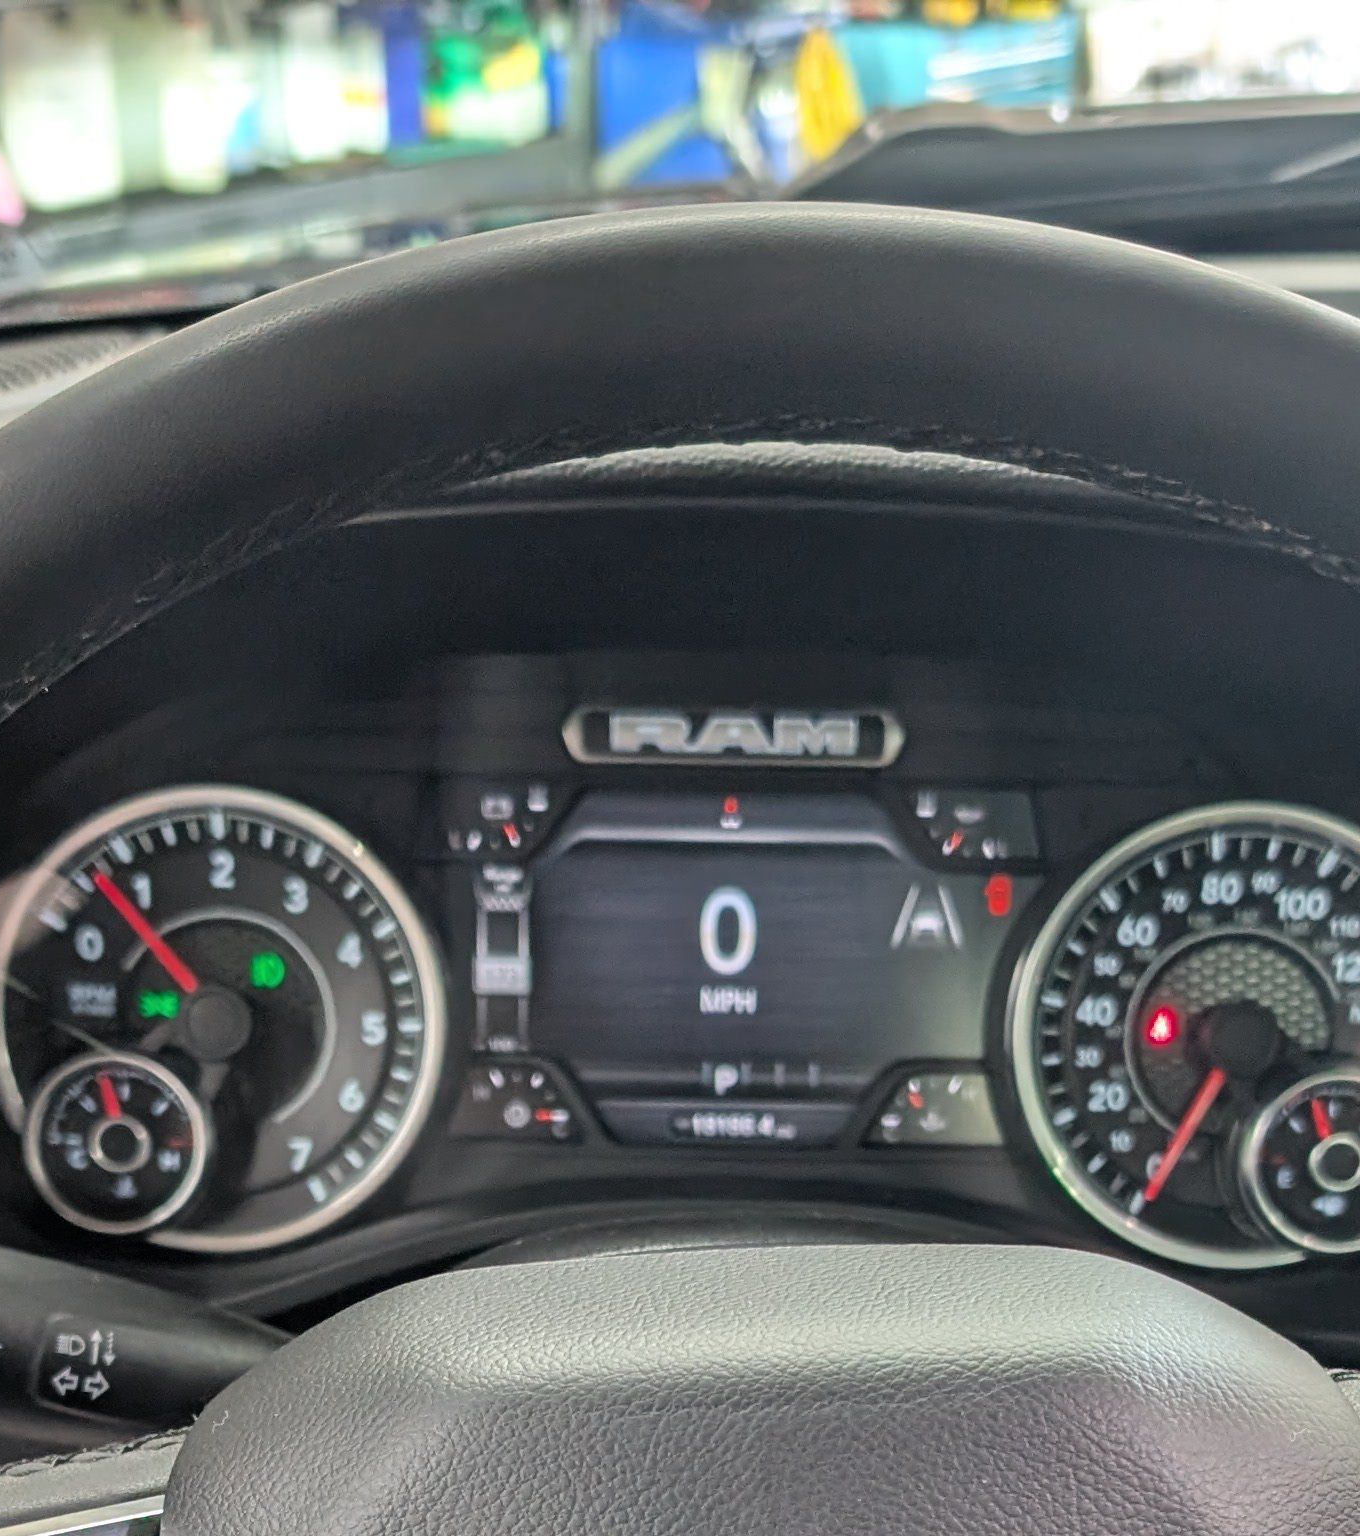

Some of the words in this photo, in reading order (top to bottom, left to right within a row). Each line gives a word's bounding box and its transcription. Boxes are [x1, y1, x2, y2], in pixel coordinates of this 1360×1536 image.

[609, 714, 858, 756] RAM
[209, 849, 236, 889] 2
[1251, 870, 1281, 894] 90
[131, 871, 151, 910] 1
[283, 874, 308, 914] 3
[1162, 889, 1189, 914] 70
[1201, 869, 1244, 905] 80
[1274, 886, 1331, 921] 100
[74, 924, 105, 962] 0
[700, 885, 757, 976] 0
[1117, 914, 1160, 947] 60
[337, 932, 363, 969] 4
[1093, 953, 1122, 977] 50
[700, 985, 757, 1014] MPH
[1076, 995, 1118, 1027] 40
[361, 1010, 388, 1046] 5
[1075, 1044, 1103, 1068] 30
[339, 1078, 365, 1113] 6
[714, 1064, 739, 1096] P
[1087, 1080, 1128, 1112] 20
[289, 1136, 314, 1172] 7
[1109, 1129, 1135, 1152] 10
